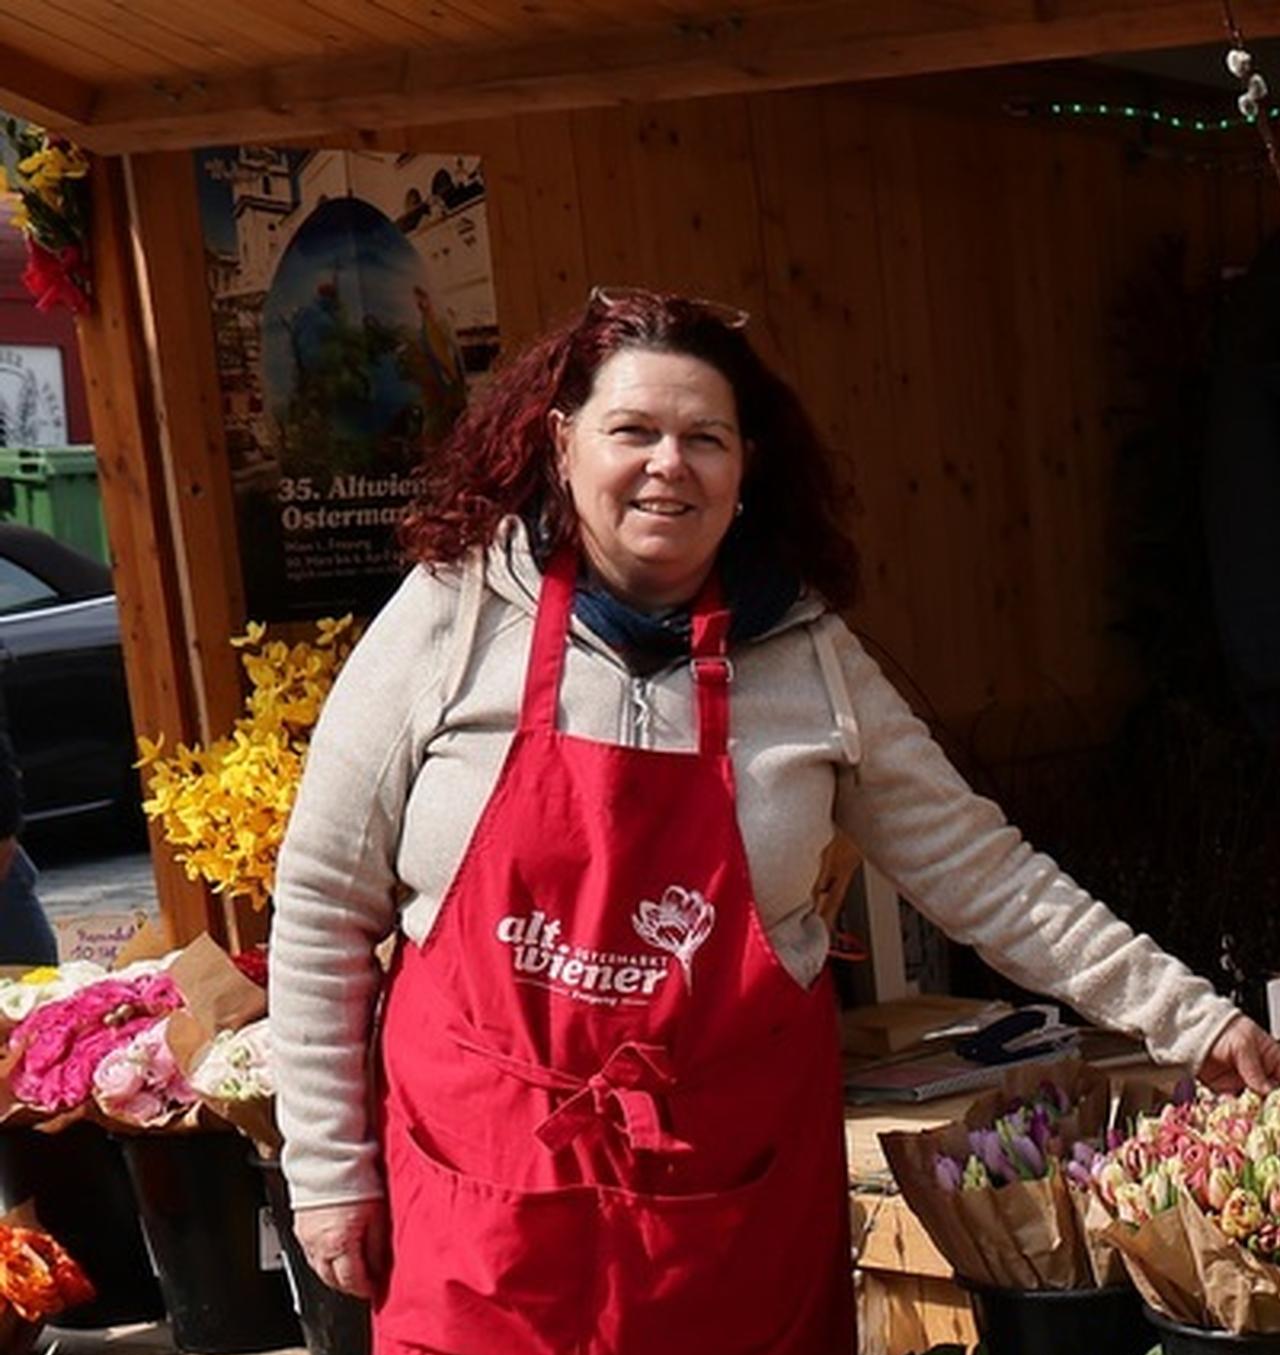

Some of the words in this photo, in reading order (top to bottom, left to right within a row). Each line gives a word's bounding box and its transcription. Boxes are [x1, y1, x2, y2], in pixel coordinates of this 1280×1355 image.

[278, 478, 320, 500] 35.
[497, 911, 562, 949] alt
[514, 944, 668, 995] wiener
